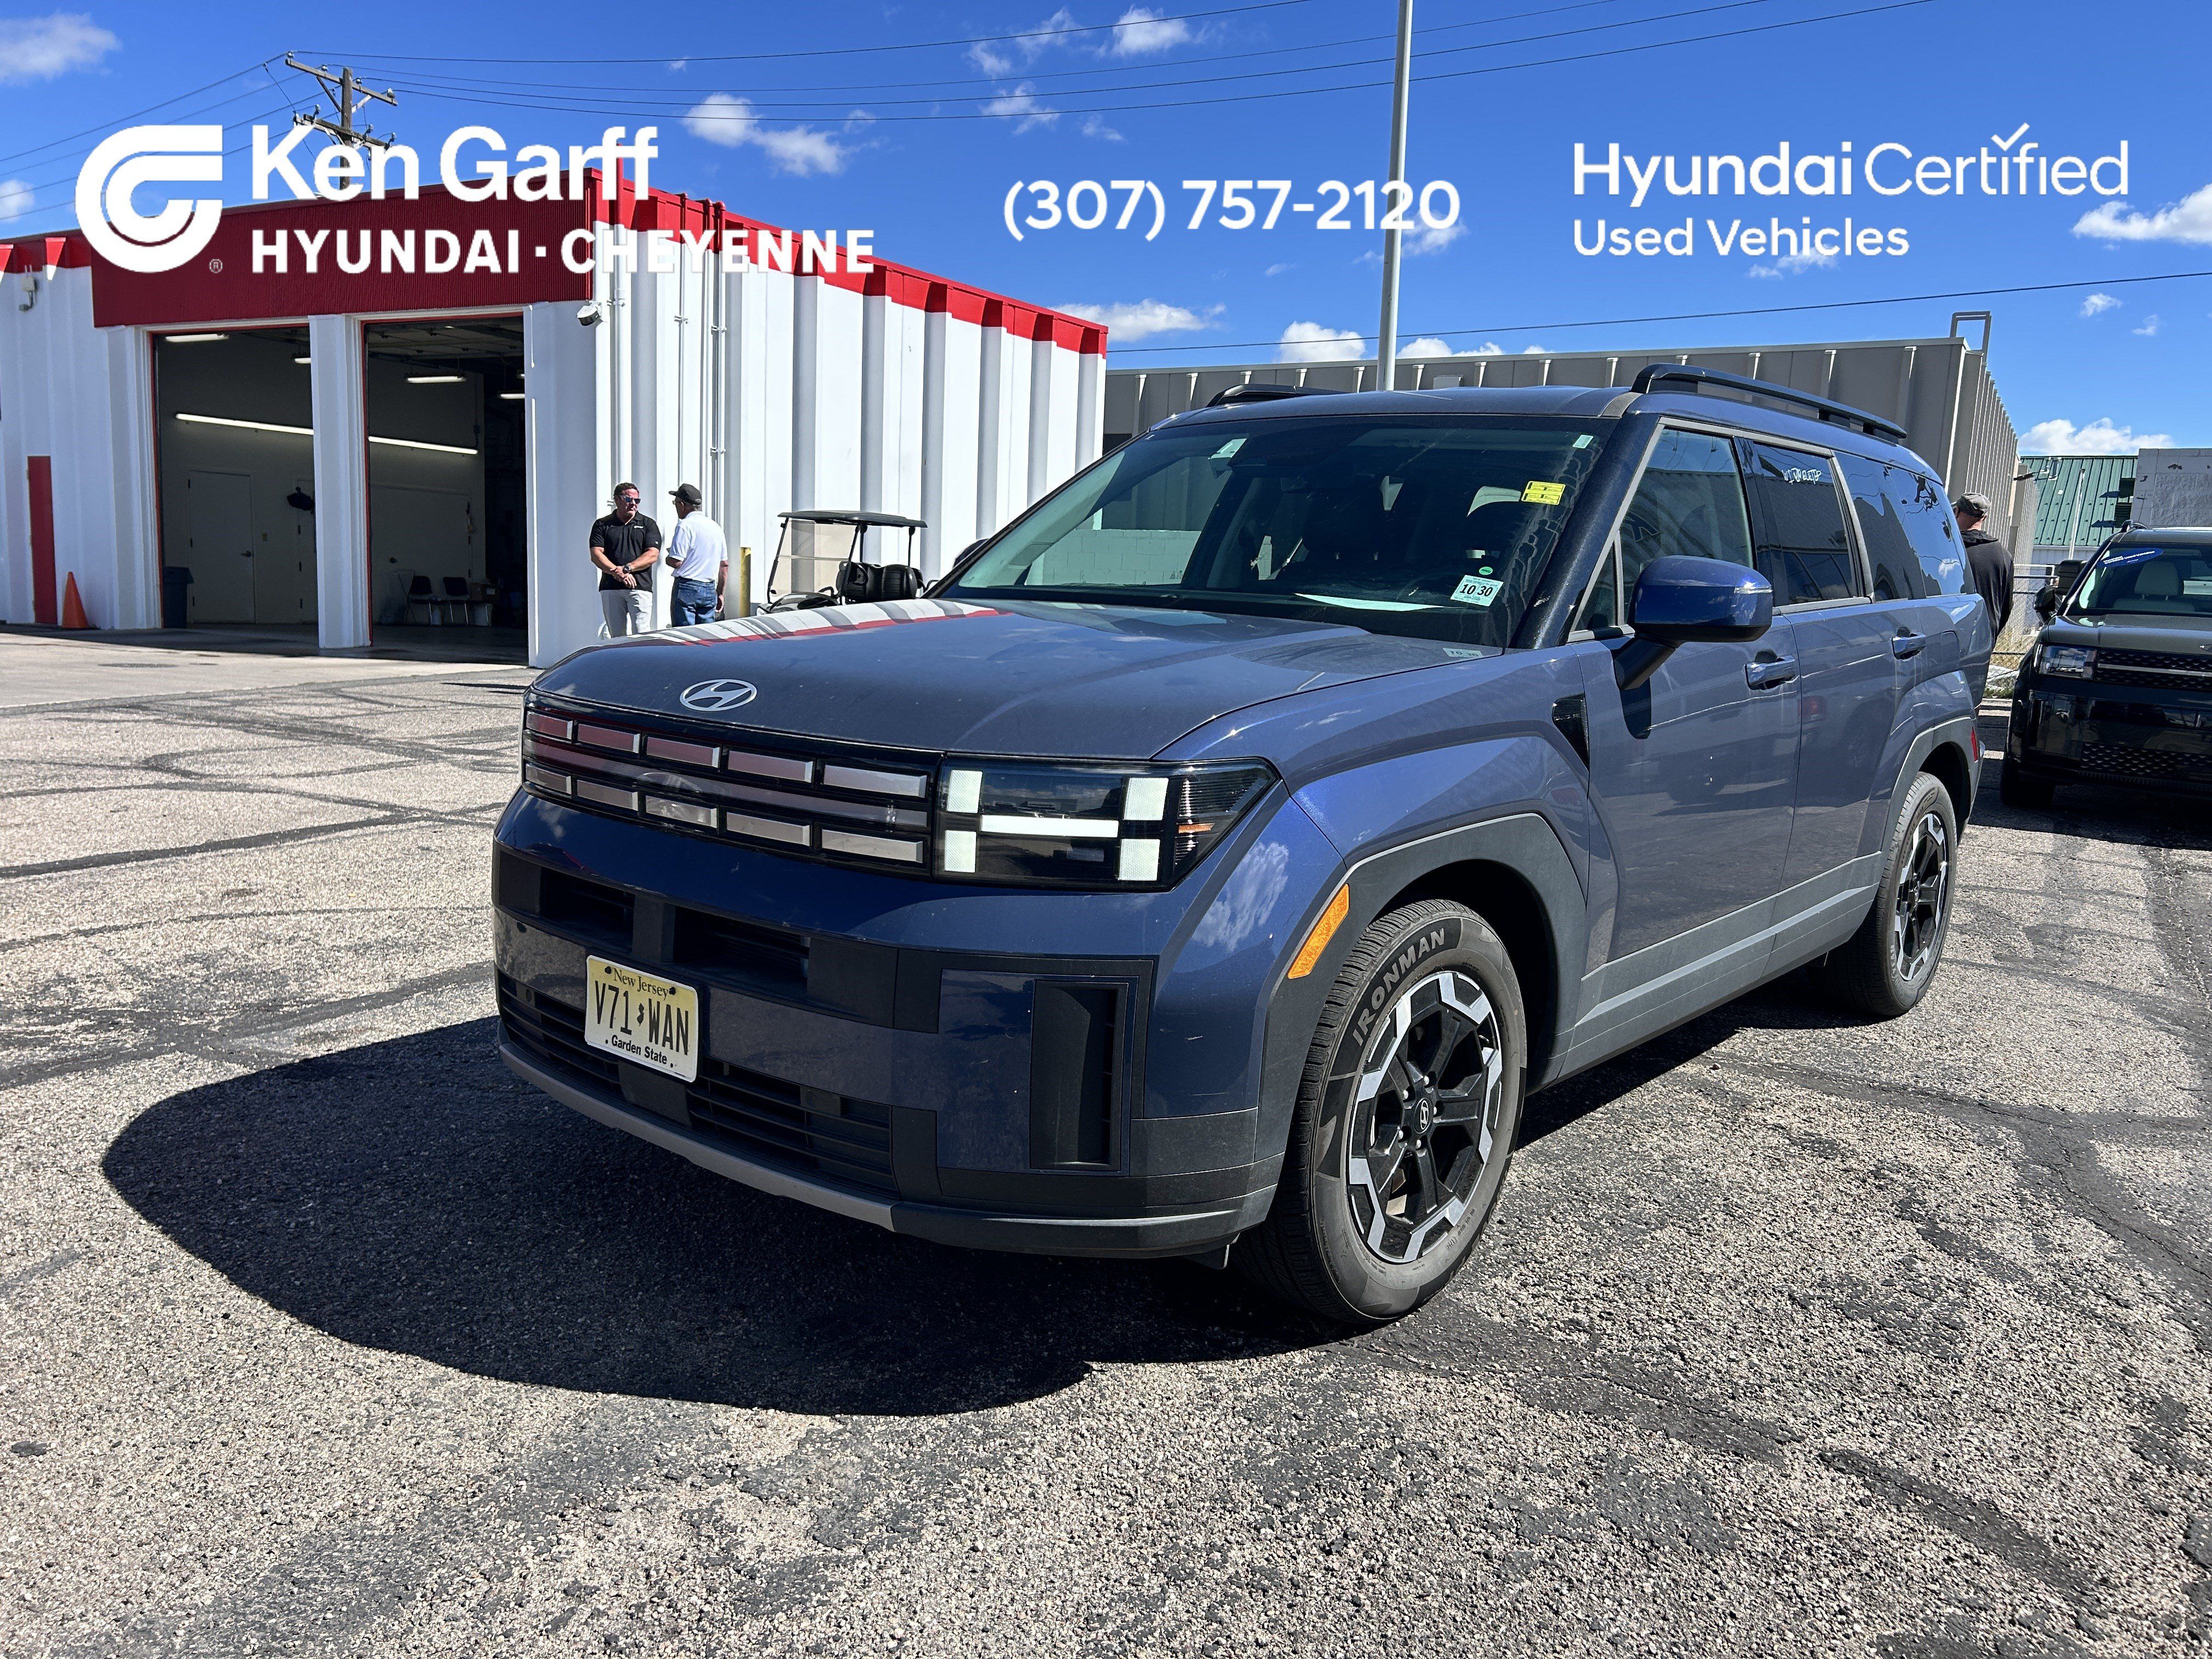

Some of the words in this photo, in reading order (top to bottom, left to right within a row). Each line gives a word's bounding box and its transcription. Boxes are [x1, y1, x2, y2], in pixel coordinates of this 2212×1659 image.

[1460, 584, 1476, 594] 10
[1477, 586, 1493, 596] 30
[613, 967, 636, 986] New
[637, 975, 669, 1001] Jersey
[1352, 928, 1444, 1047] IRONMAN
[595, 980, 632, 1036] V71
[648, 997, 689, 1056] WAN
[611, 1034, 641, 1056] Garden
[644, 1046, 668, 1065] State
